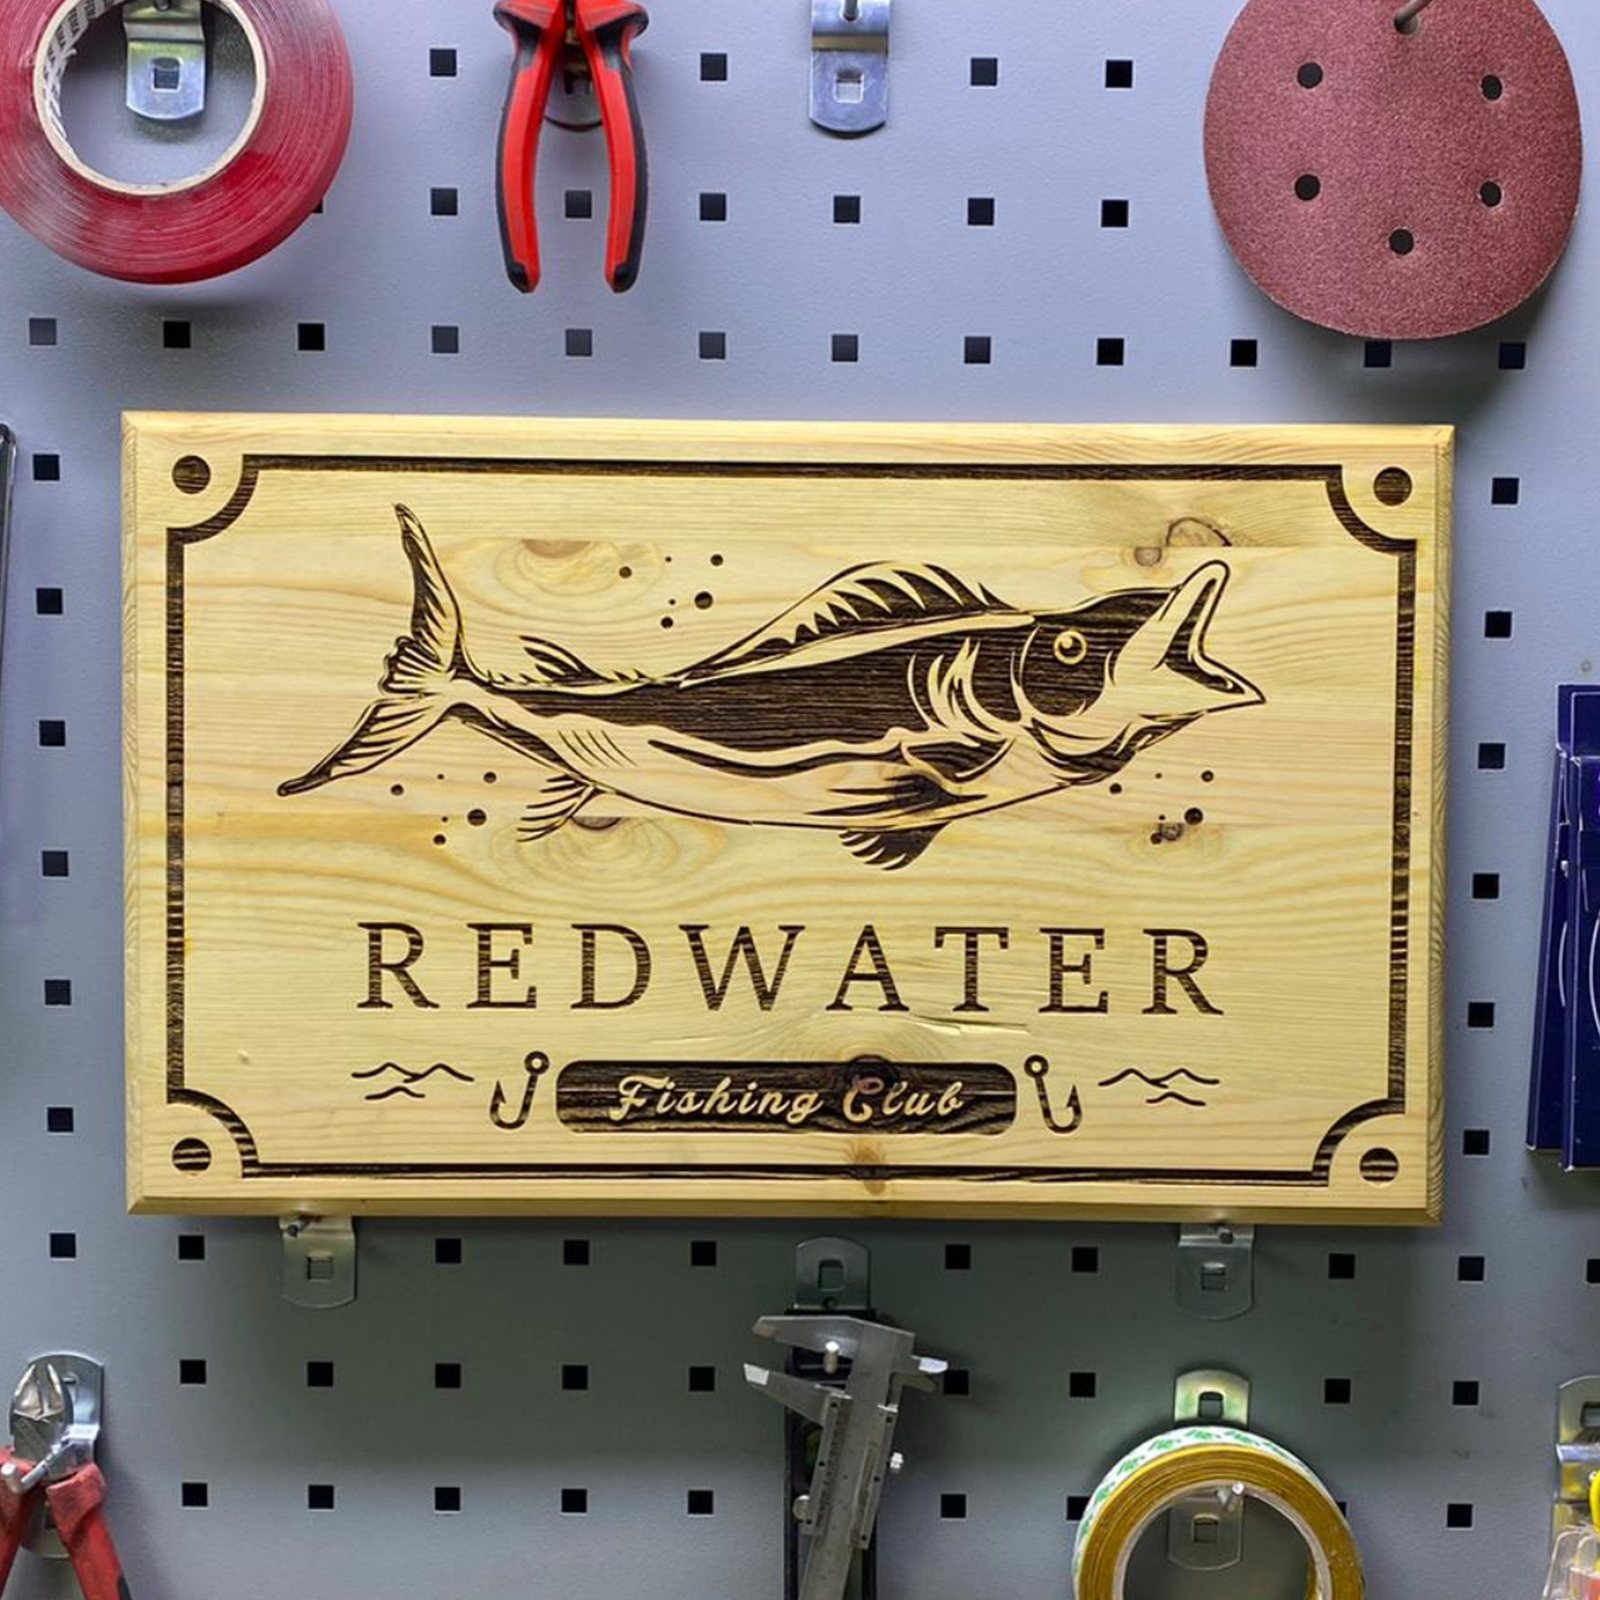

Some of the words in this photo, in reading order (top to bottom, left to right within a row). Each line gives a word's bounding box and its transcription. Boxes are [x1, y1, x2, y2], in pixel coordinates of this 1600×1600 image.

[357, 921, 1225, 1016] REDWATER
[609, 1075, 824, 1124] Fishing
[843, 1077, 964, 1123] Club
